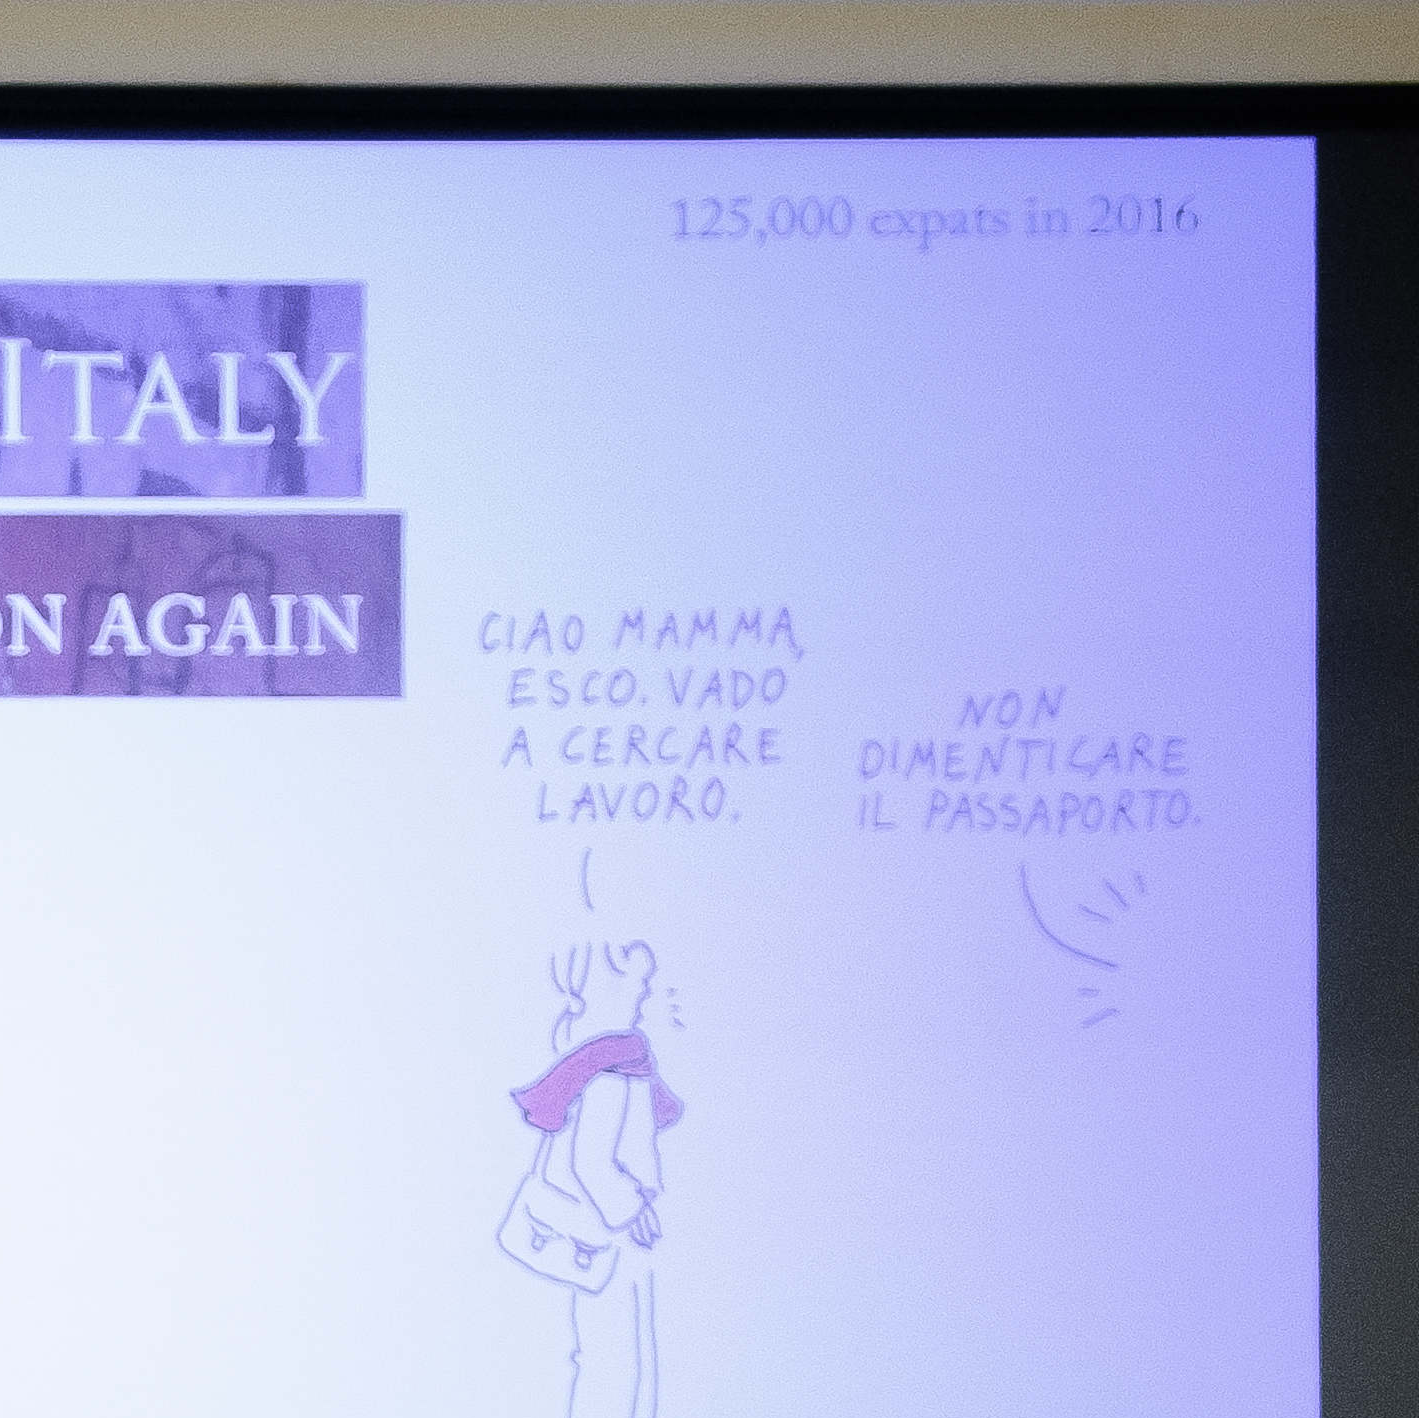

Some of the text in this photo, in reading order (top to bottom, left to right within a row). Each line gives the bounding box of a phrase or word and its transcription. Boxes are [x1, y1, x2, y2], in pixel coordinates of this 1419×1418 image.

[669, 192, 1203, 254] 125,000 expats in 2016
[87, 590, 365, 658] AGAIN
[477, 603, 807, 664] CIAO MAMMA,
[505, 665, 791, 712] ESCO. VADO
[955, 683, 1069, 730] NON
[500, 720, 785, 770] A CERCARE
[855, 733, 1191, 784] DIMENTICARE
[535, 776, 743, 824] LAVORO.
[857, 786, 1205, 838] IL PASSAPORTO.
